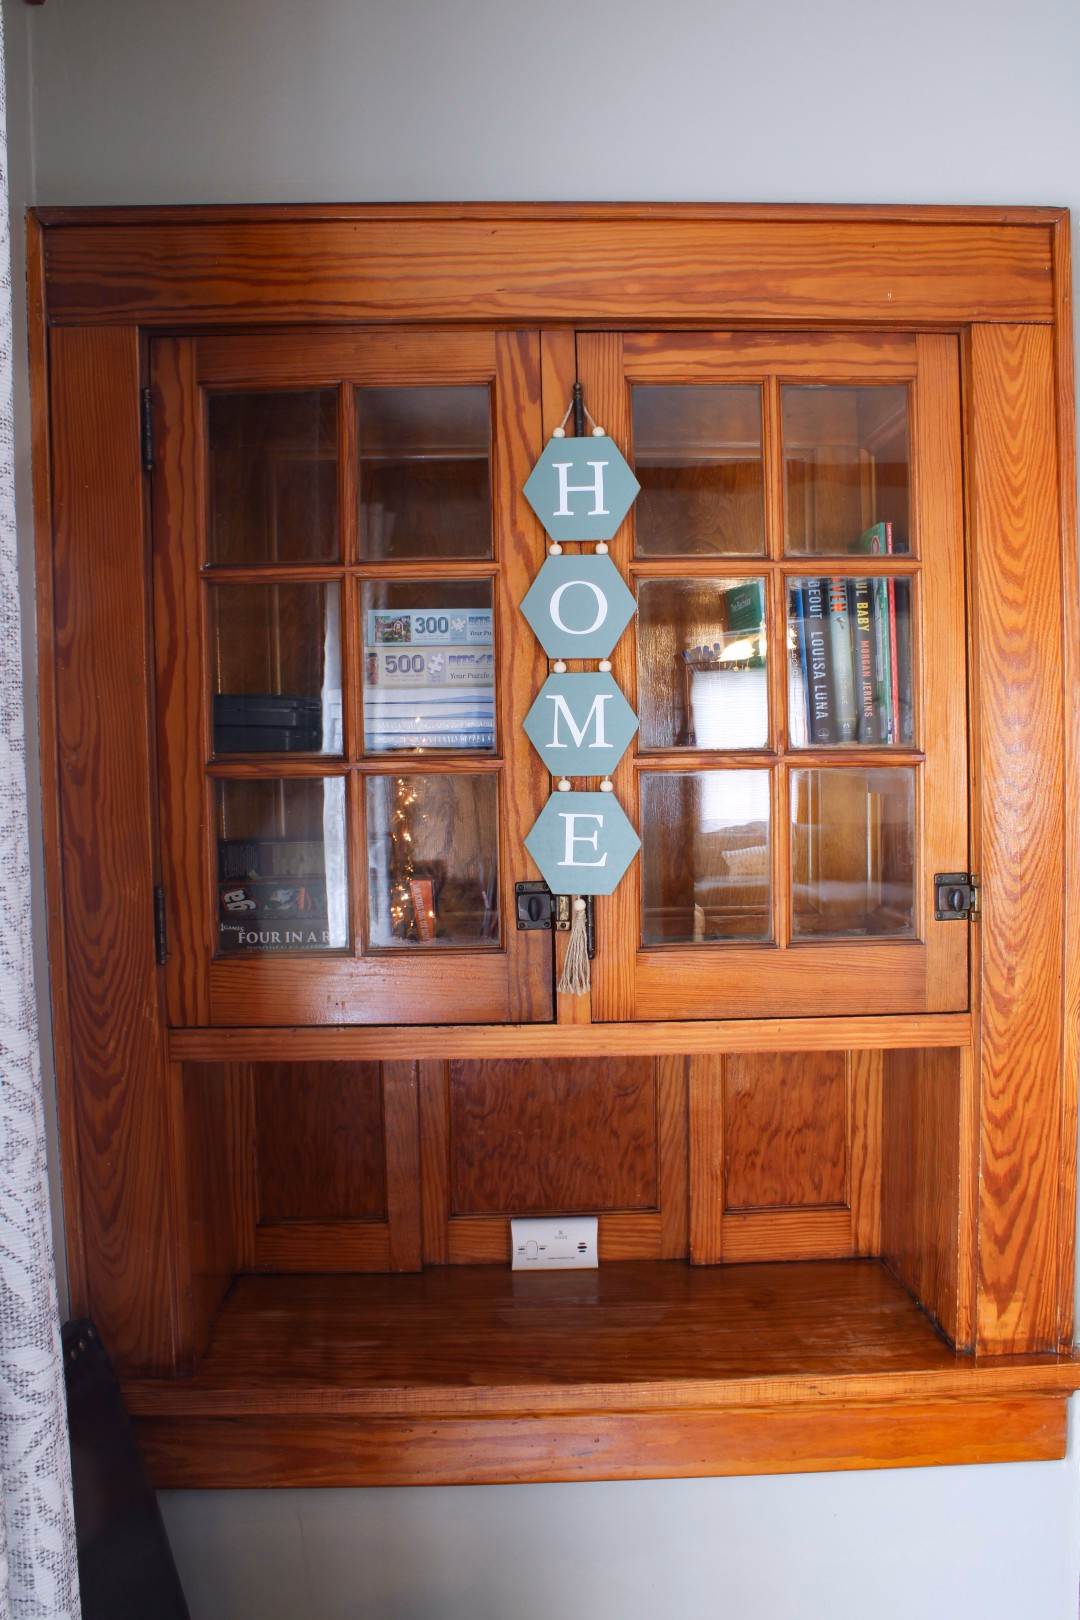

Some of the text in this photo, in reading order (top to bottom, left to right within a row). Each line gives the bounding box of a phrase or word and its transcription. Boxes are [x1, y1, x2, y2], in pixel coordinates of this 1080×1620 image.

[414, 616, 449, 634] 300
[856, 602, 870, 632] BABY
[384, 654, 424, 673] 500
[546, 461, 614, 867] HOME
[811, 632, 826, 680] LOUISA
[861, 640, 872, 677] MORGAN
[814, 685, 829, 720] LUNA
[862, 681, 873, 717] JERKINS
[238, 931, 281, 944] FOUR
[285, 931, 303, 943] IN
[307, 931, 318, 943] A
